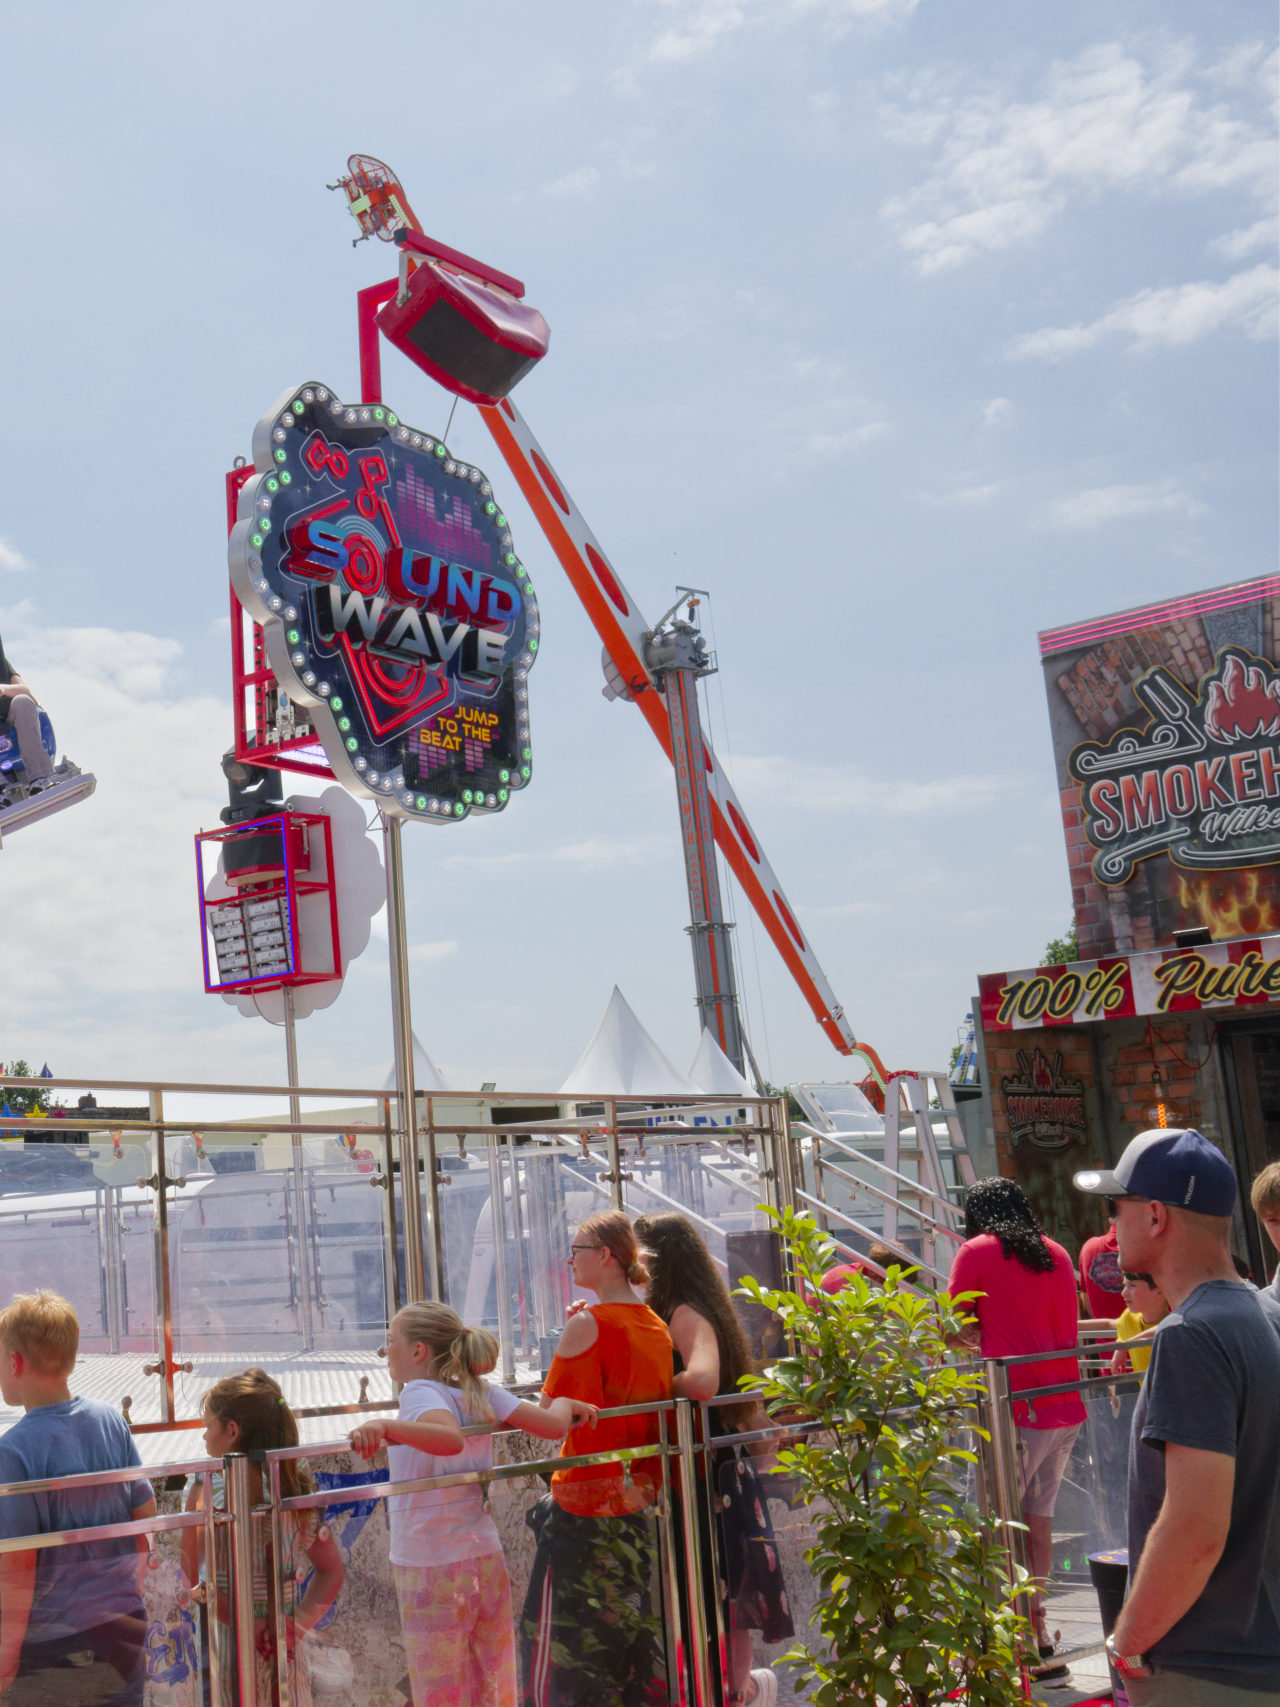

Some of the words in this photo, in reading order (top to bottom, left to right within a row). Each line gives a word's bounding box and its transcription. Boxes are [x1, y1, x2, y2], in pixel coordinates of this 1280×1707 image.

[300, 518, 521, 624] SOUND
[314, 582, 511, 679] WAVE
[437, 716, 458, 733] TO
[462, 723, 491, 742] THE
[454, 705, 499, 727] JUMP
[420, 728, 462, 751] BEAT
[996, 963, 1128, 1024] 100%
